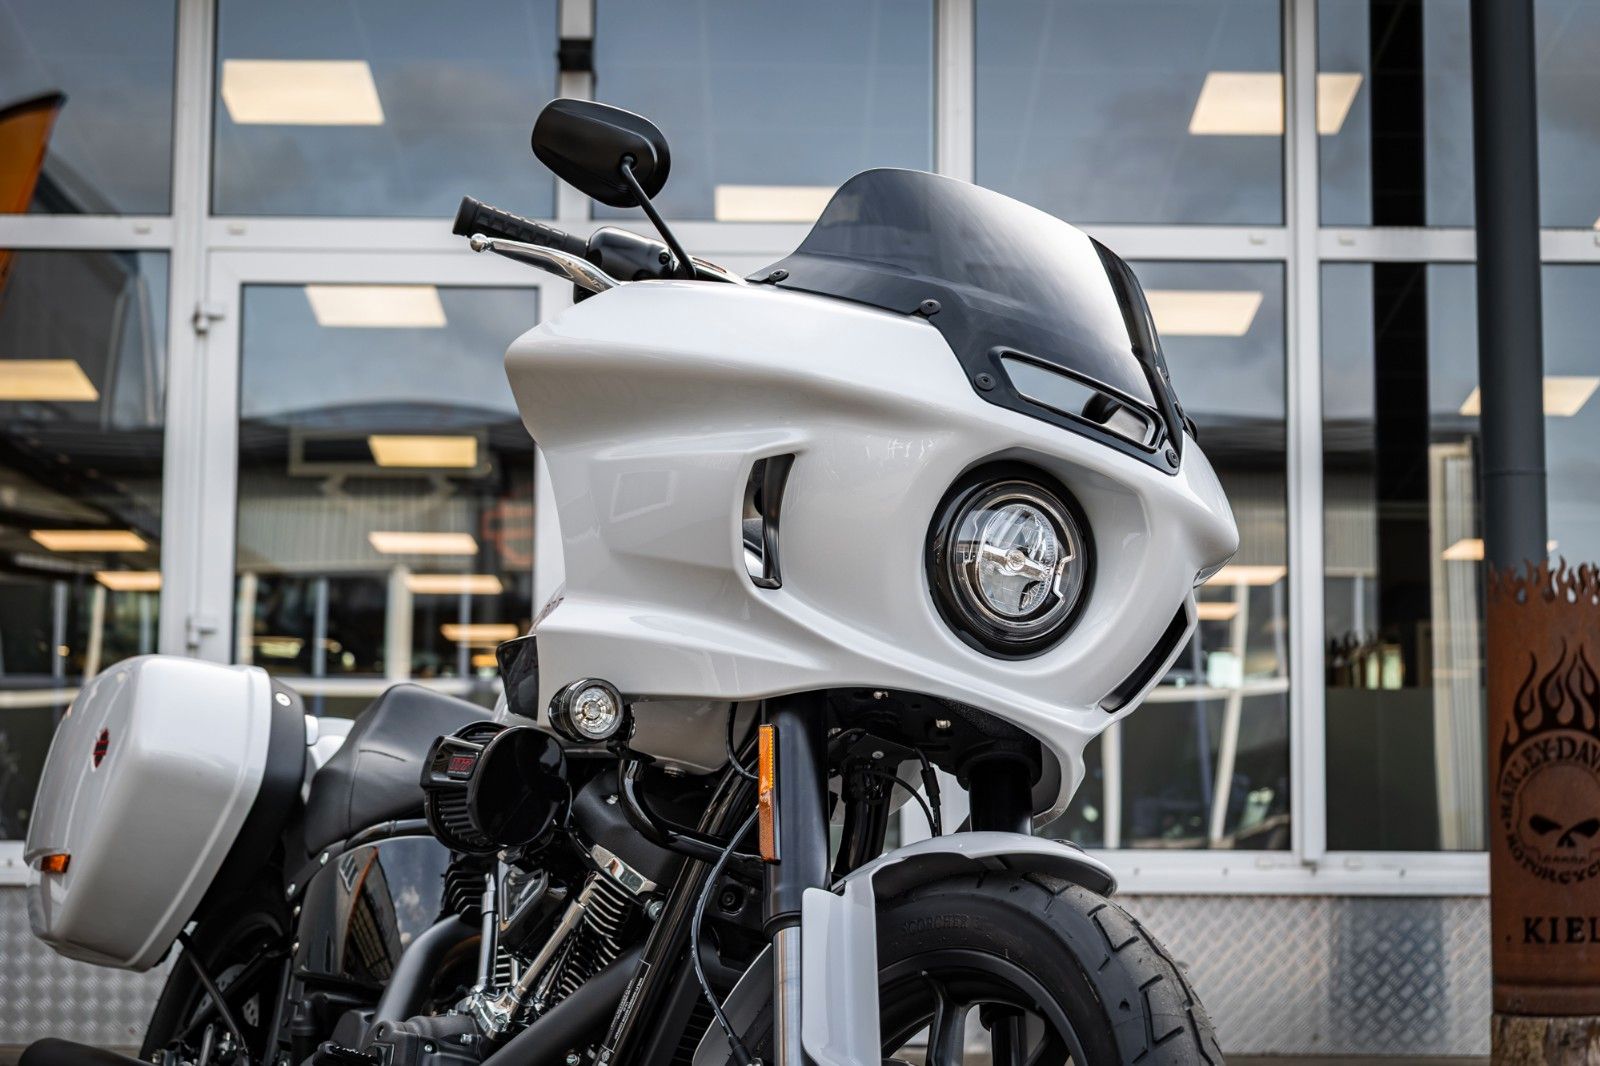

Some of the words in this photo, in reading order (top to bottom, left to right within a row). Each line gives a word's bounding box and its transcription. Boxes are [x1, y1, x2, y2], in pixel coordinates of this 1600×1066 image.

[1501, 736, 1600, 820] HARLEY-DAV
[1506, 833, 1600, 885] MOTORCYC
[1523, 916, 1600, 944] KIEL
